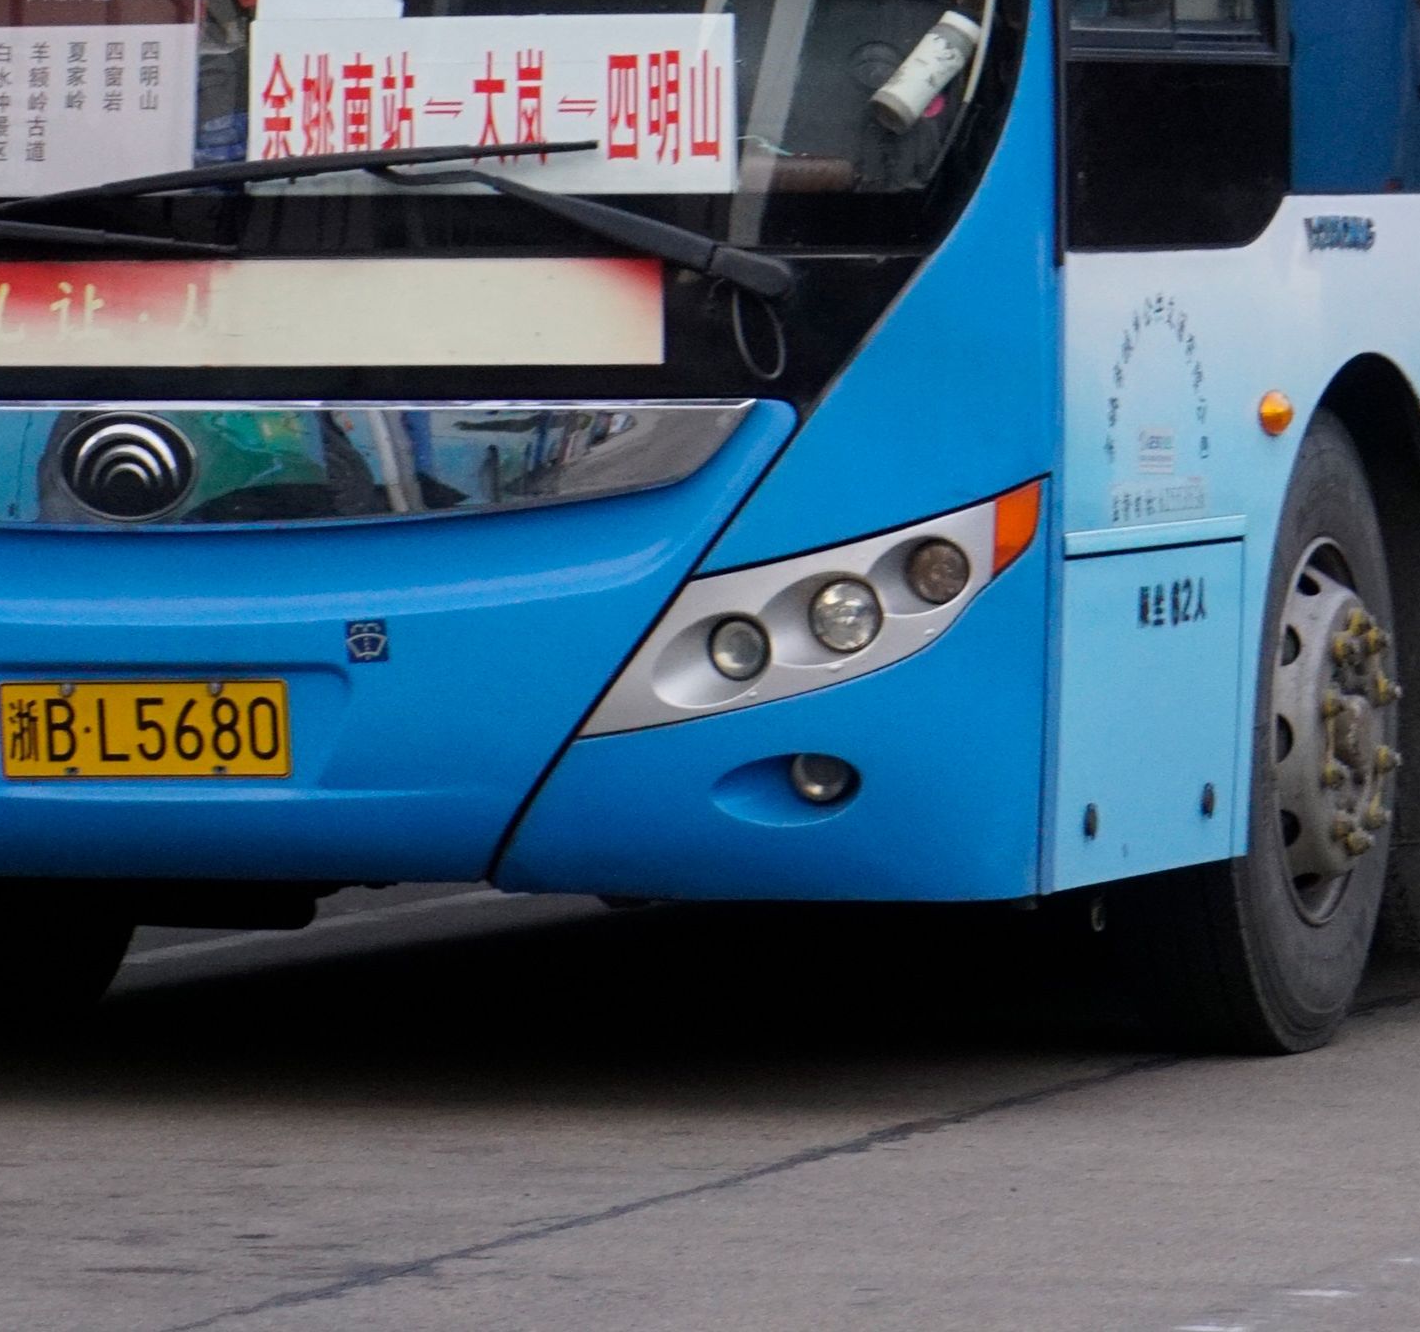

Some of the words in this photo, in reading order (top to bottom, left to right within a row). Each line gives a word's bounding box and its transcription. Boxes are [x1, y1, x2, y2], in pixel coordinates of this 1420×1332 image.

[25, 42, 50, 163] 羊额岭古道
[65, 41, 88, 111] 夏家岭
[102, 41, 126, 112] 四窗岩
[139, 40, 161, 111] 四明山
[262, 52, 415, 165] 余姚南站
[473, 49, 548, 165] 大岚
[608, 49, 721, 165] 四明山
[9, 696, 279, 763] 浙B·L5680
